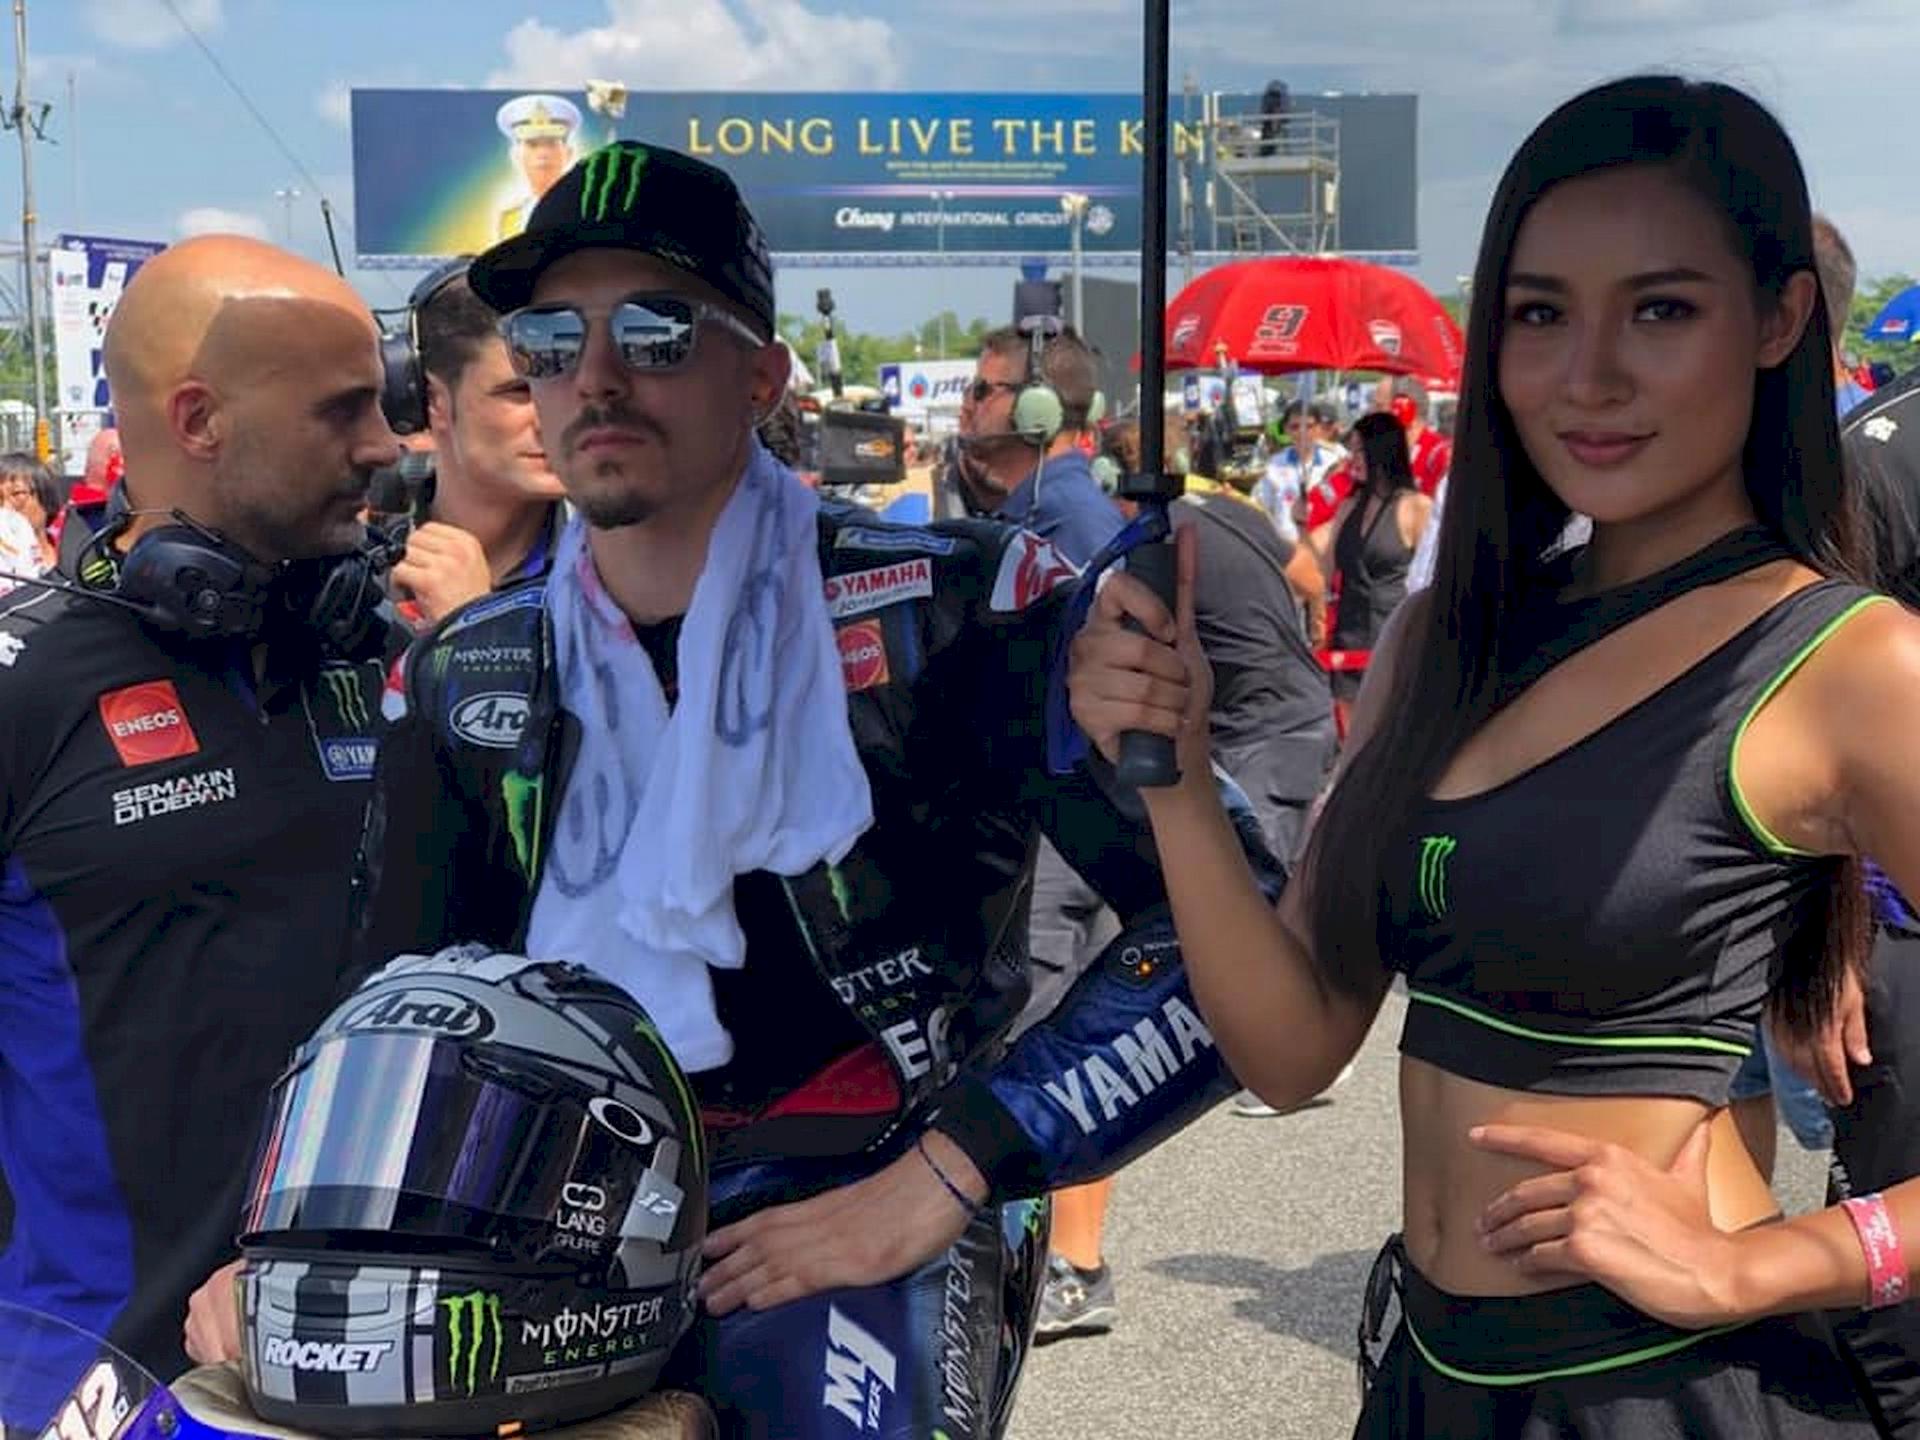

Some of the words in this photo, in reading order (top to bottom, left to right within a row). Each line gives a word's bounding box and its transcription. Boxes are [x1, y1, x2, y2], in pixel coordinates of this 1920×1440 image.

[688, 118, 833, 155] LONG
[859, 118, 974, 155] LIVE
[992, 118, 1096, 155] THE
[835, 206, 896, 231] Chang
[901, 211, 1009, 226] INTERNATIONAL
[1254, 304, 1311, 340] 9
[842, 561, 928, 596] YAMAHA
[112, 709, 180, 738] ENEOS
[112, 768, 233, 806] SEMAKIN
[114, 800, 144, 825] DI
[149, 784, 237, 816] DEPAN
[830, 947, 933, 1006] STER
[350, 991, 480, 1031] Arai
[1043, 995, 1215, 1135] YAMA
[556, 1208, 607, 1236] LANG
[264, 1336, 394, 1371] ROCKET
[543, 1333, 651, 1365] ENERGY
[823, 1301, 897, 1432] M1
